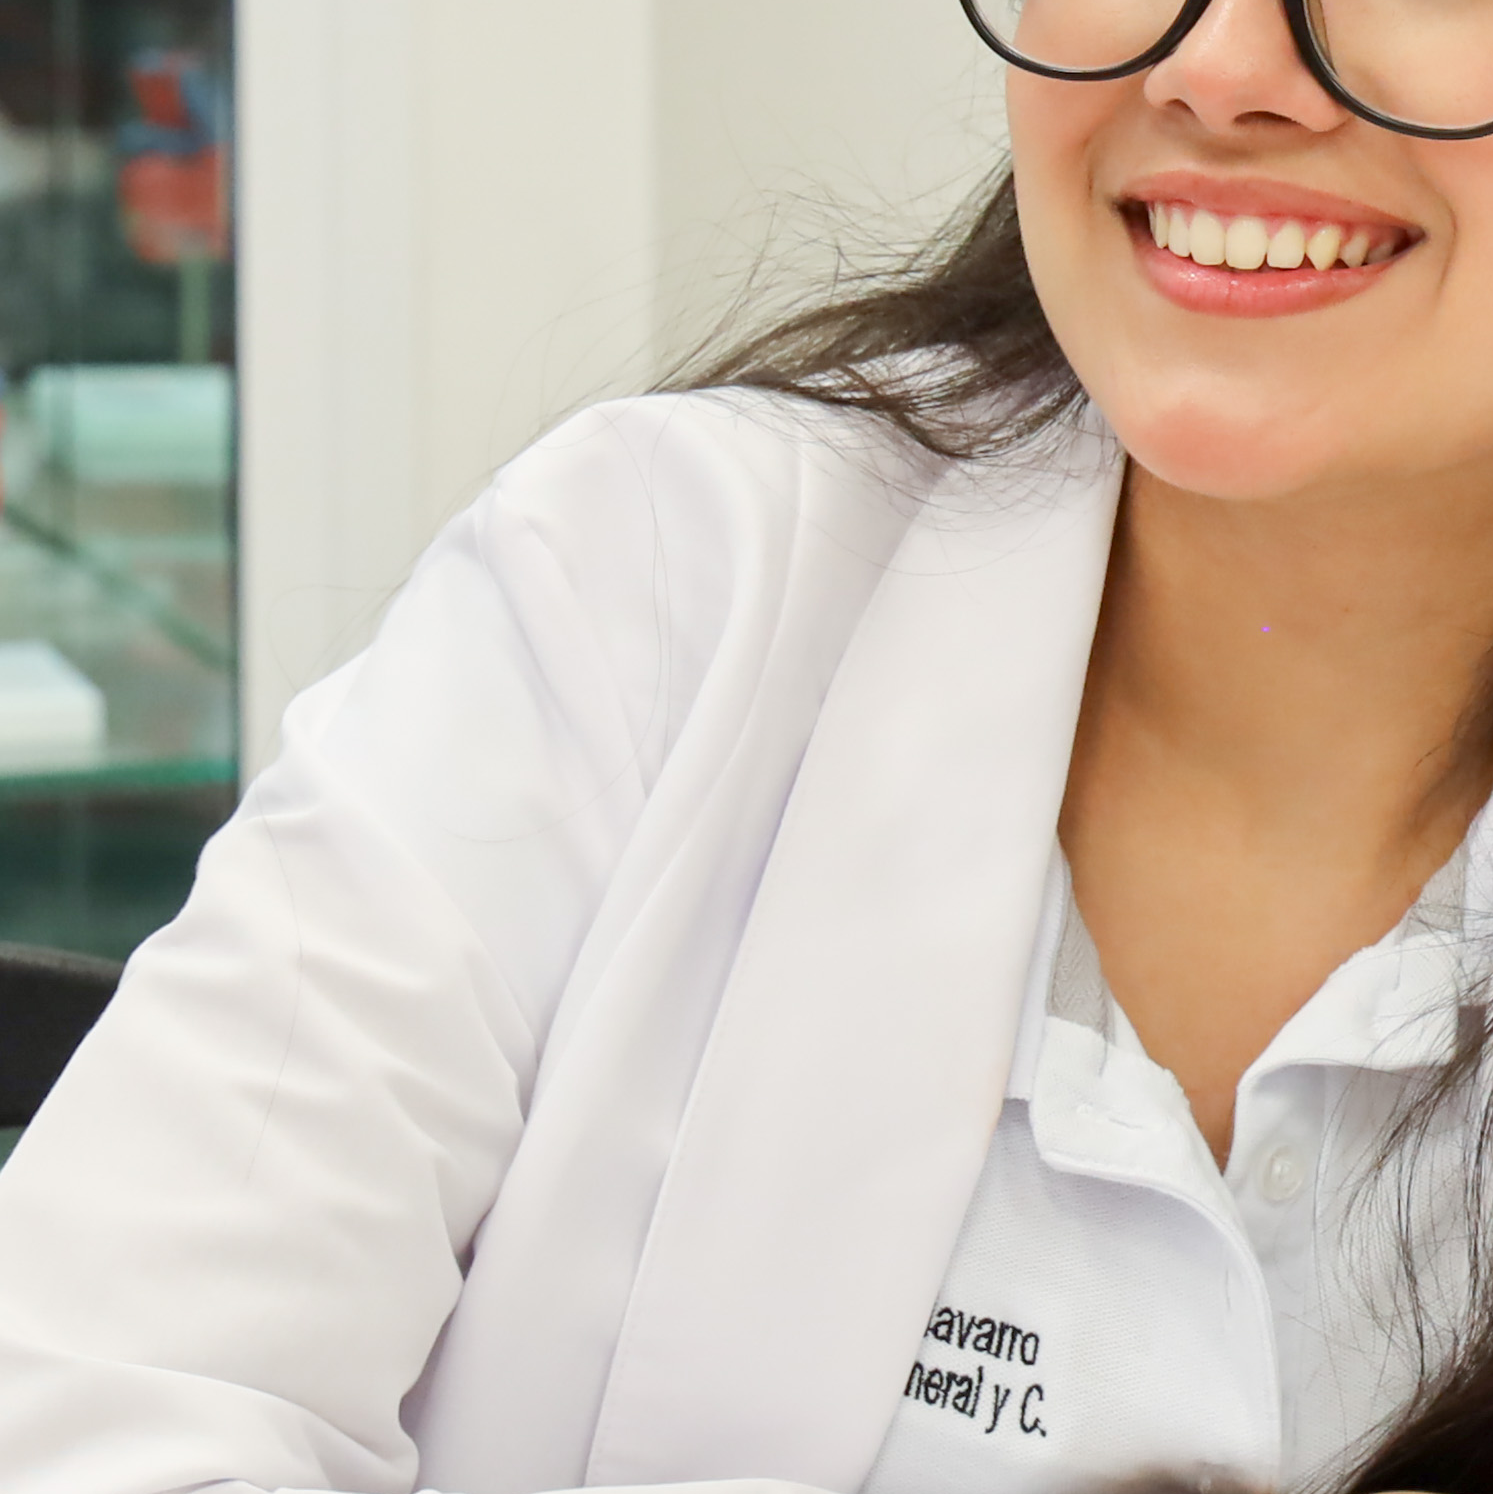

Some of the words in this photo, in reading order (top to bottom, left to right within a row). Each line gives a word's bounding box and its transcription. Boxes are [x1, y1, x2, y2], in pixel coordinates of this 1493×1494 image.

[924, 1307, 1040, 1365] avarro
[985, 1384, 1010, 1434] y
[1020, 1384, 1047, 1437] C.
